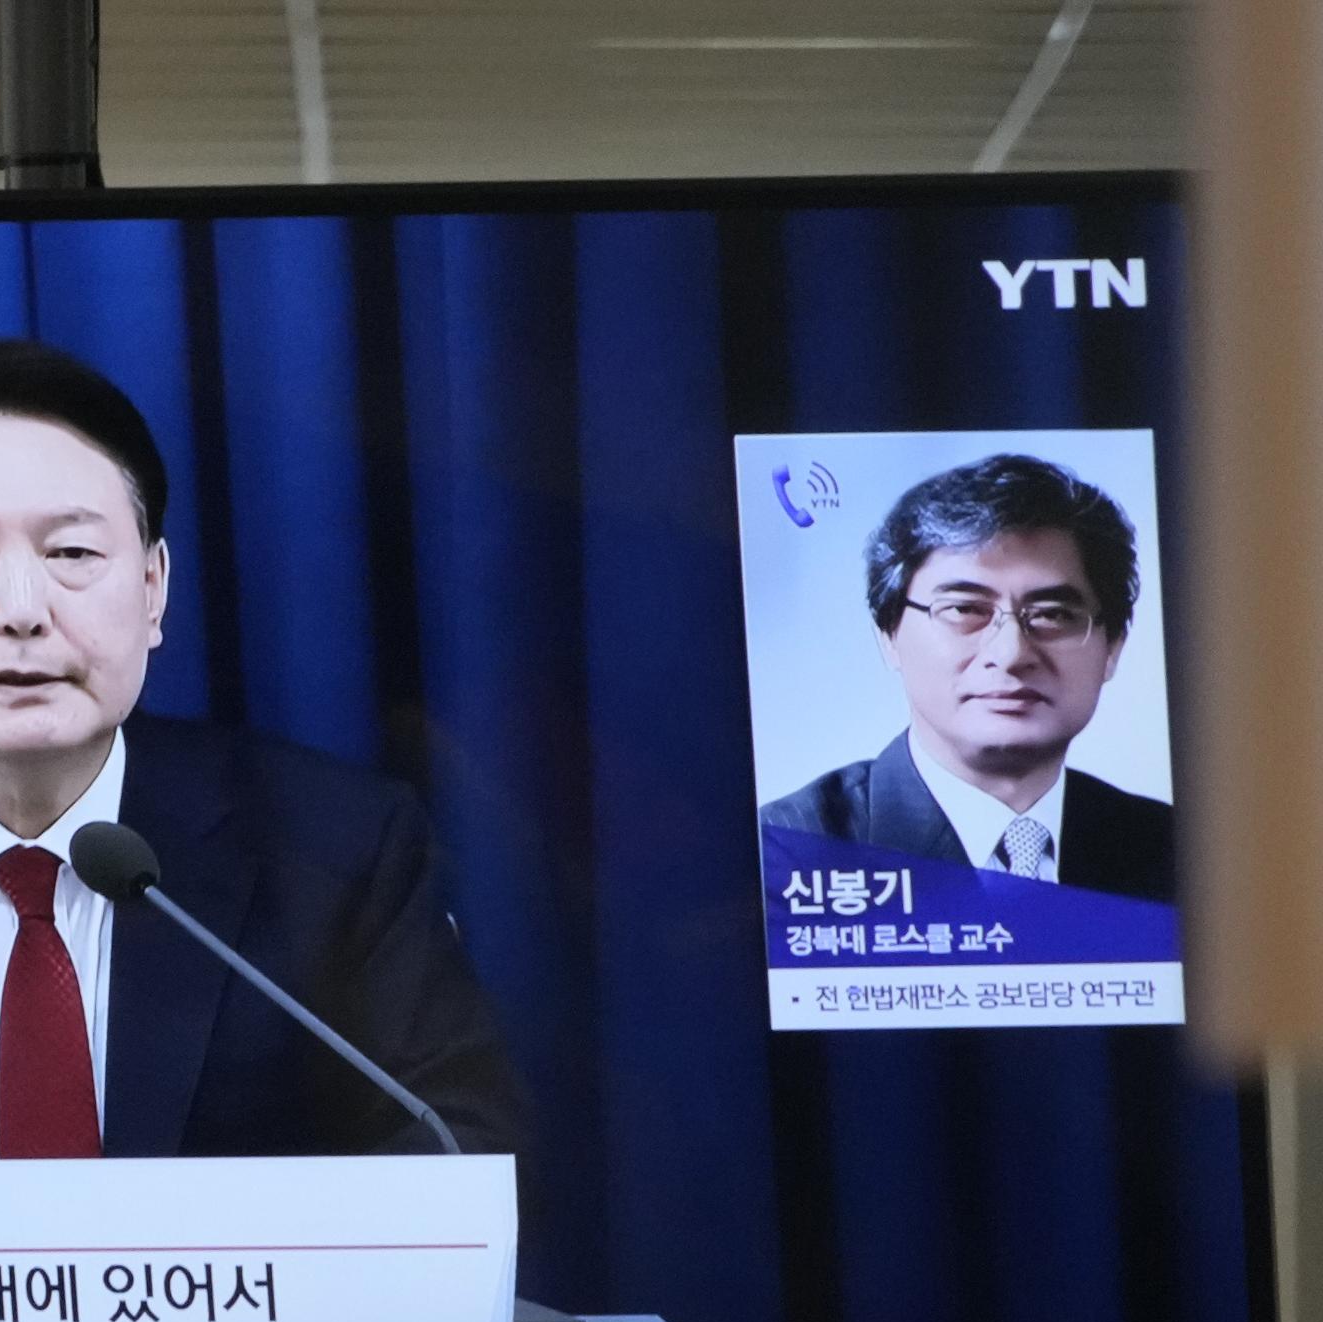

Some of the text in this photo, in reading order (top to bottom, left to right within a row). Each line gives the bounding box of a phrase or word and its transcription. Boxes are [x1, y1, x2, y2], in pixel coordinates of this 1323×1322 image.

[982, 258, 1147, 309] YTN
[811, 499, 839, 508] YTN
[782, 869, 912, 915] 신봉기
[787, 923, 1013, 956] 경북대 로스쿨 교수
[816, 981, 1155, 1011] 전 헌법재판소 공보담당 연구관
[103, 1263, 276, 1322] 있어서
